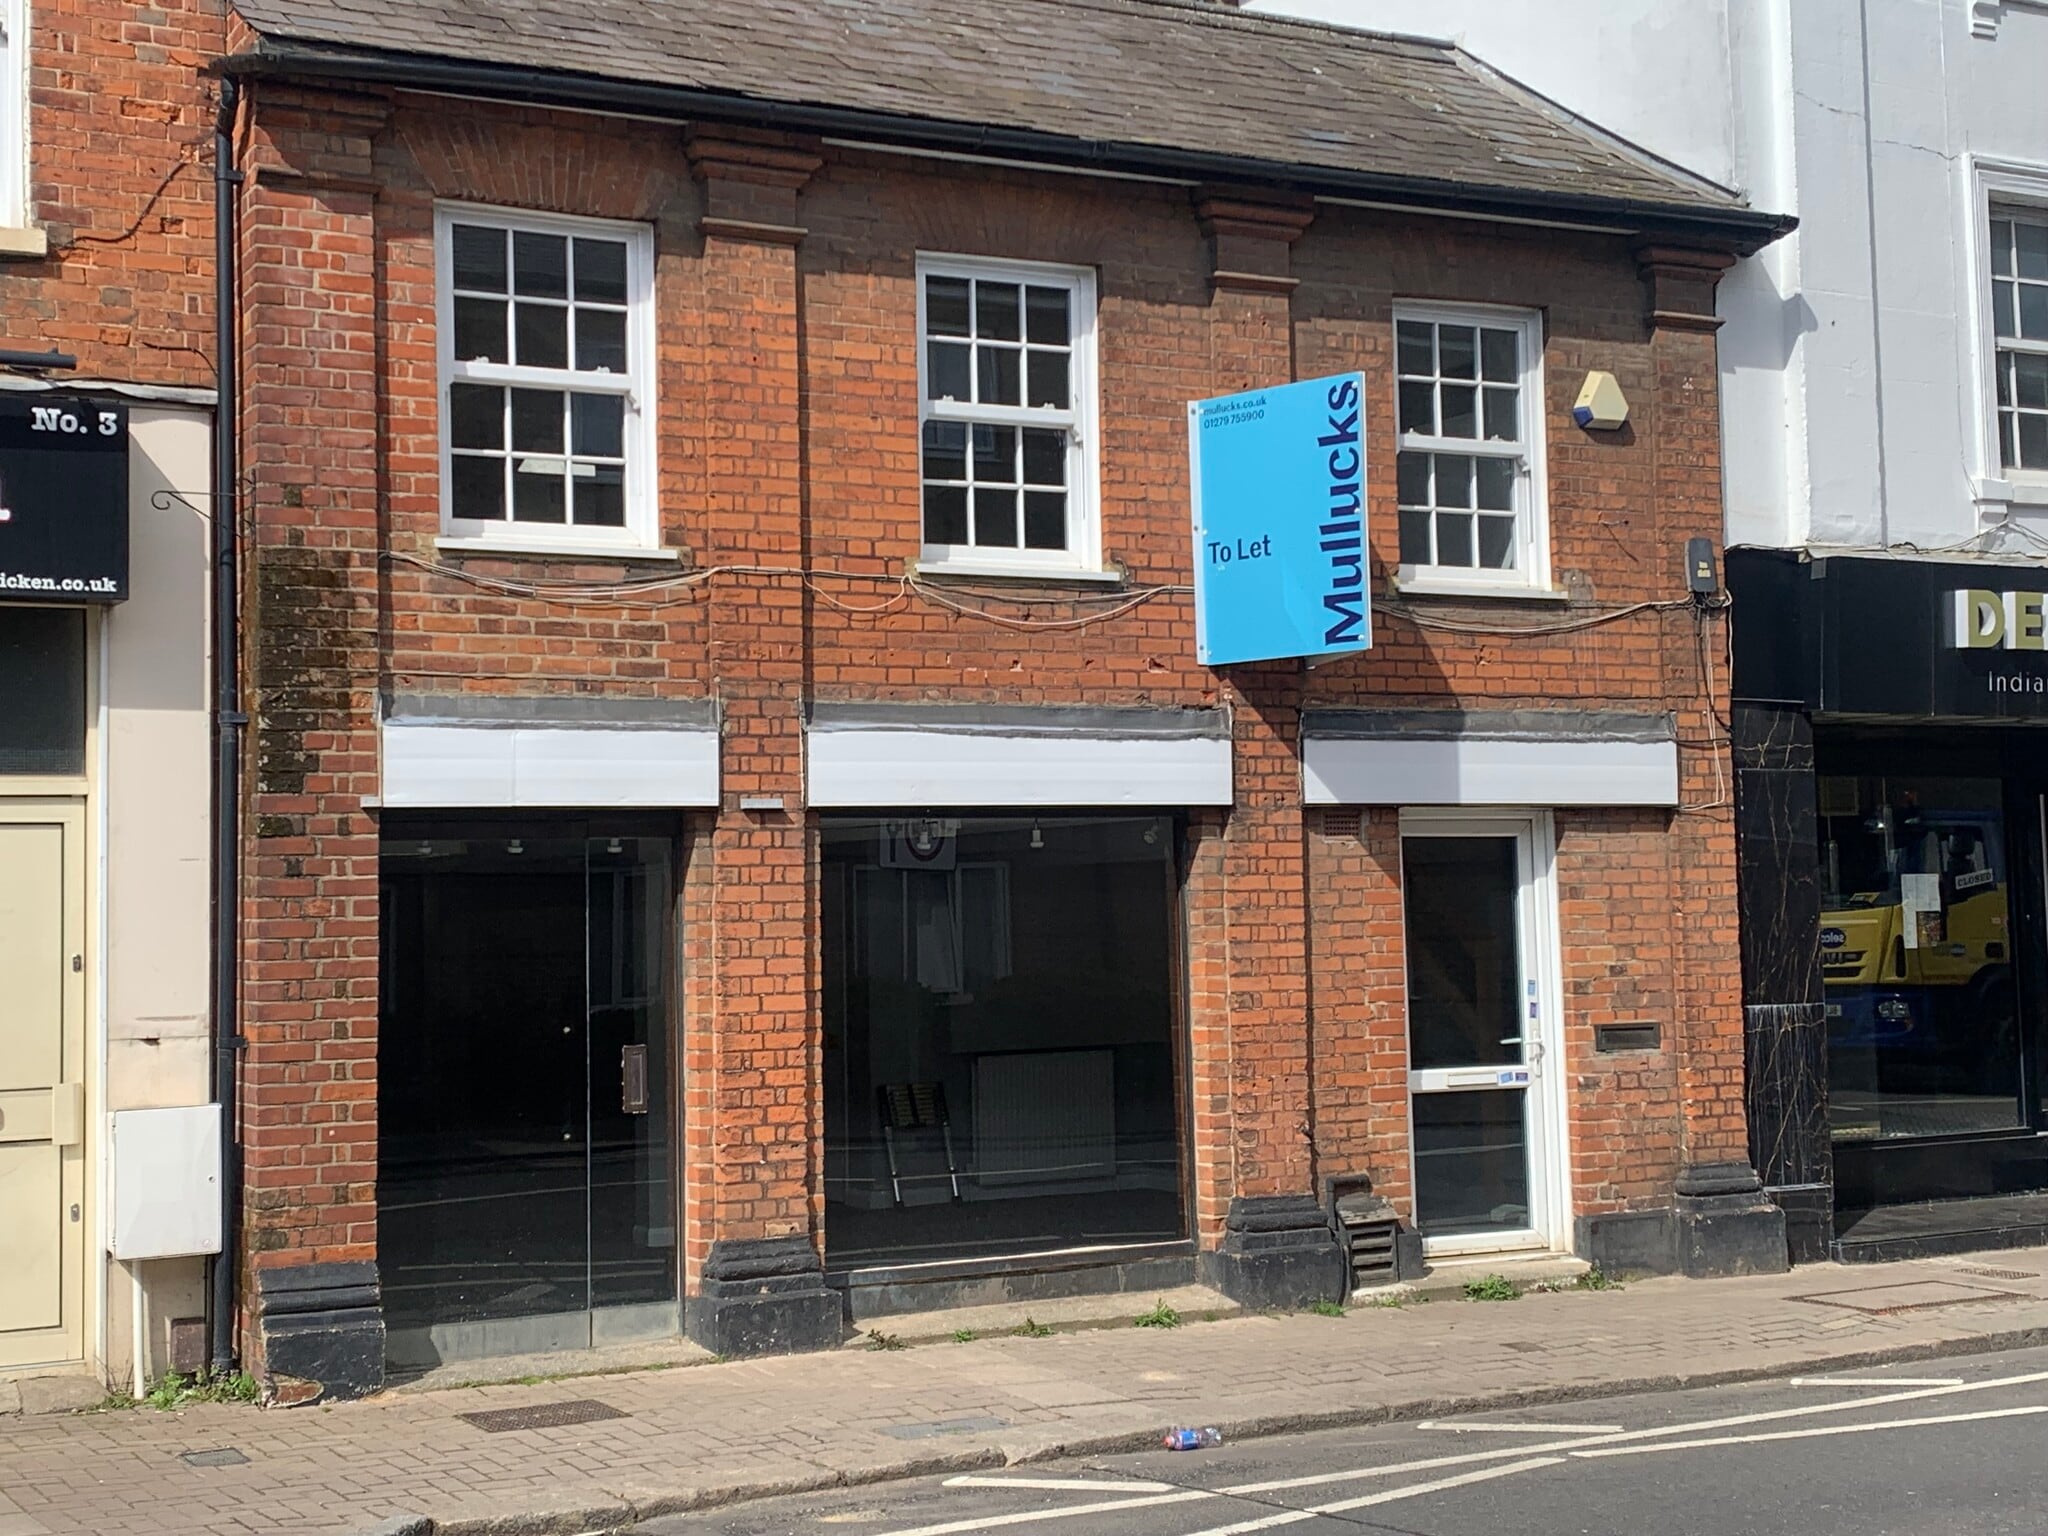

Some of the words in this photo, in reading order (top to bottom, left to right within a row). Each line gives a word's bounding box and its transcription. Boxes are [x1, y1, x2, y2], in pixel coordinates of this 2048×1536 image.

[1203, 396, 1267, 415] mullucks.co.uk
[31, 407, 88, 434] No.
[98, 412, 118, 436] 3
[1204, 415, 1230, 429] 01279
[1231, 410, 1265, 425] 755900
[1317, 380, 1364, 646] Mullucks
[1207, 541, 1232, 564] To
[1237, 534, 1272, 560] Let
[0, 572, 117, 592] icken.co.uk
[1955, 589, 2048, 651] DE
[1988, 671, 2048, 693] India
[1957, 872, 1992, 887] CLOSED
